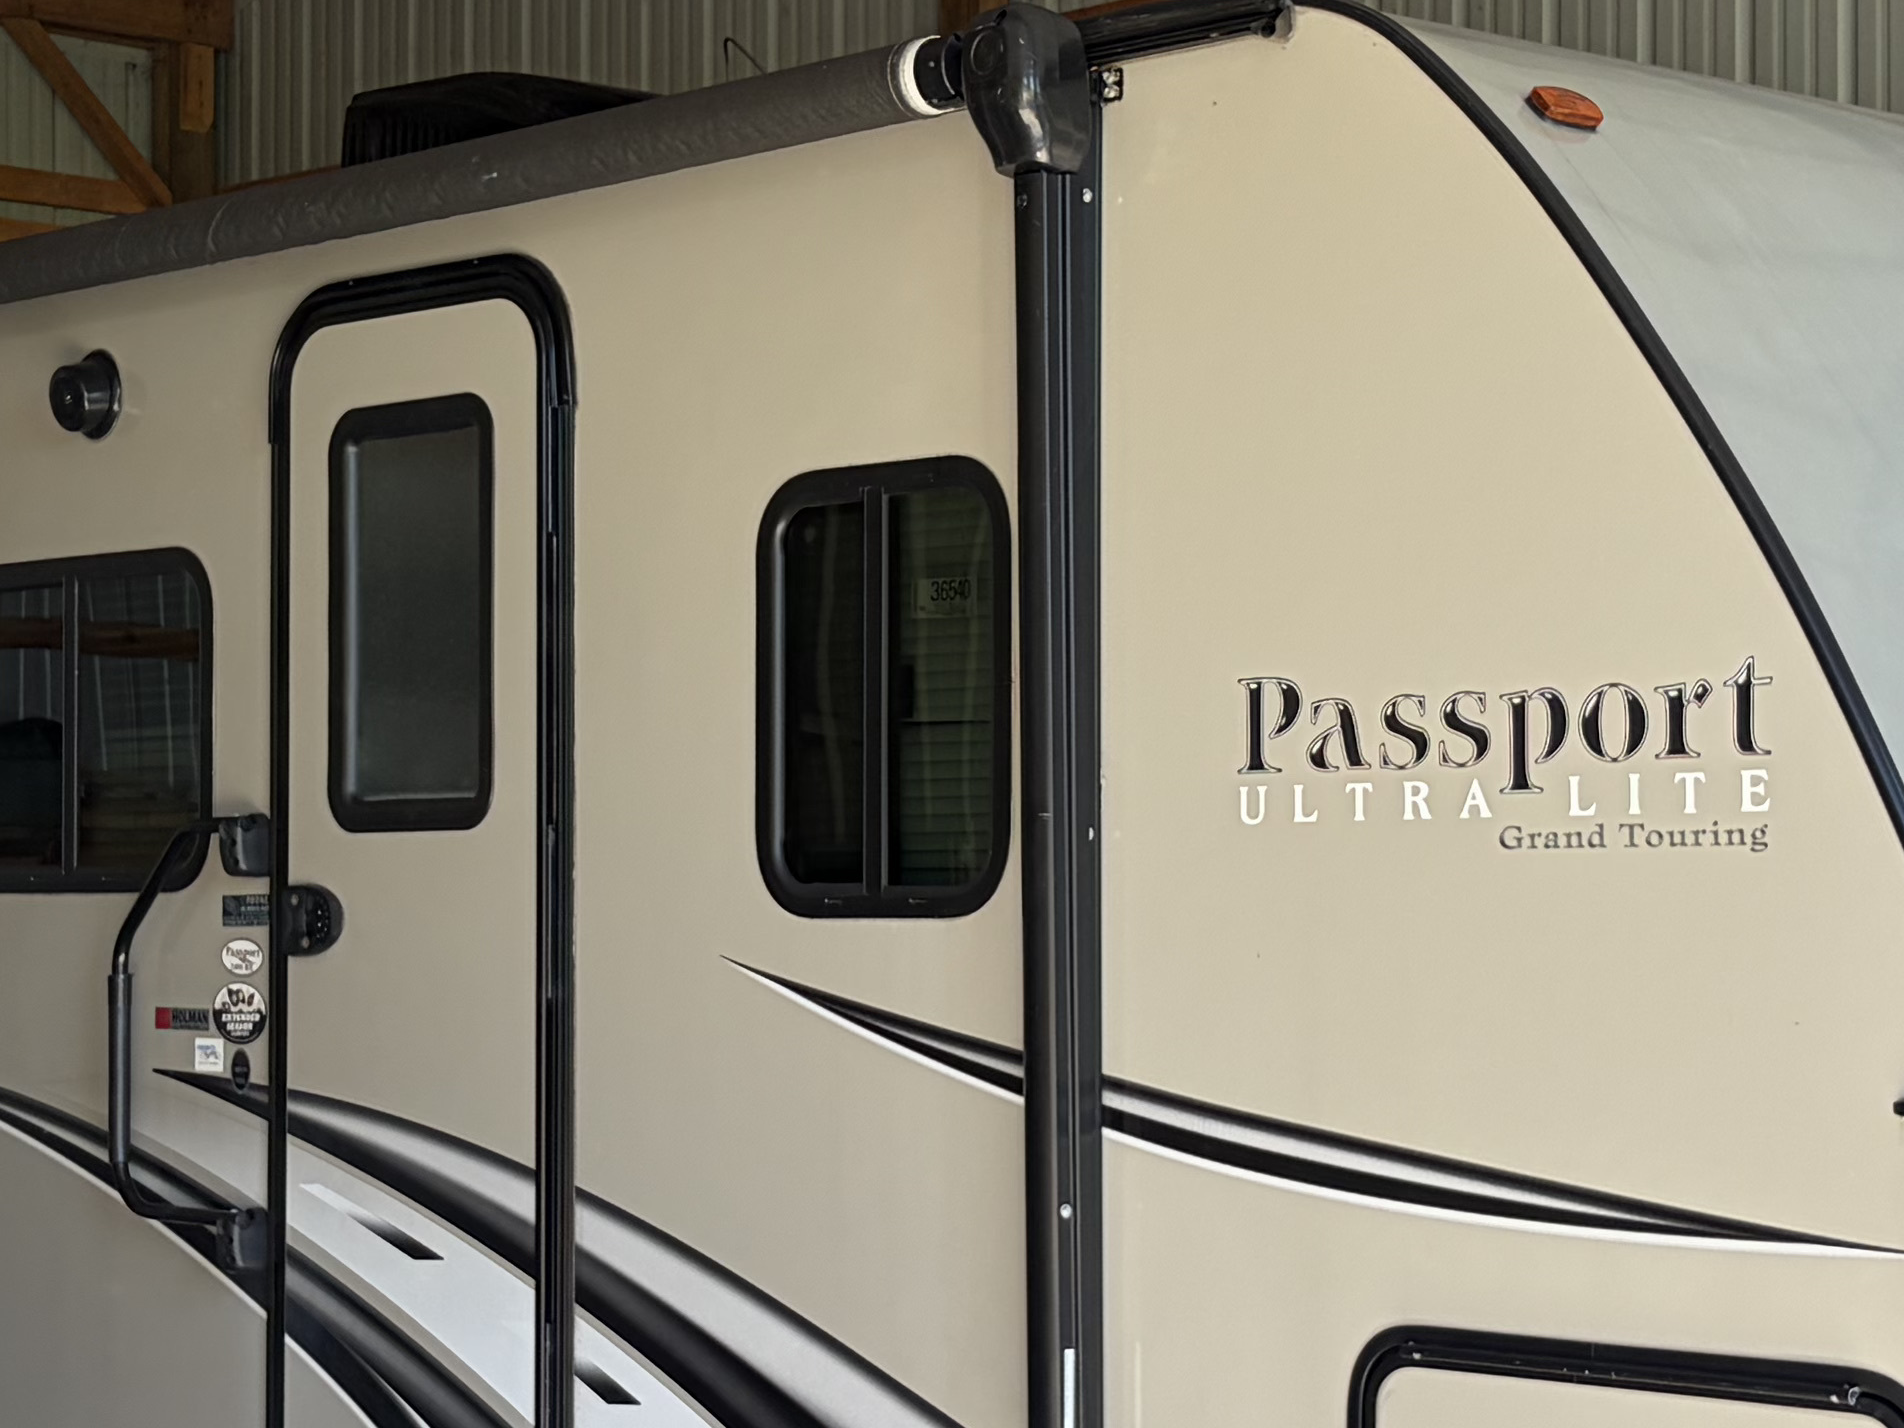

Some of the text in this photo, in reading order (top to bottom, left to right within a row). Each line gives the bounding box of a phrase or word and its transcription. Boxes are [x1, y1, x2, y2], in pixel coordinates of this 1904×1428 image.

[1236, 655, 1773, 794] Passport
[1239, 769, 1771, 825] ULTRA LITE
[1499, 820, 1770, 852] Grand Touring
